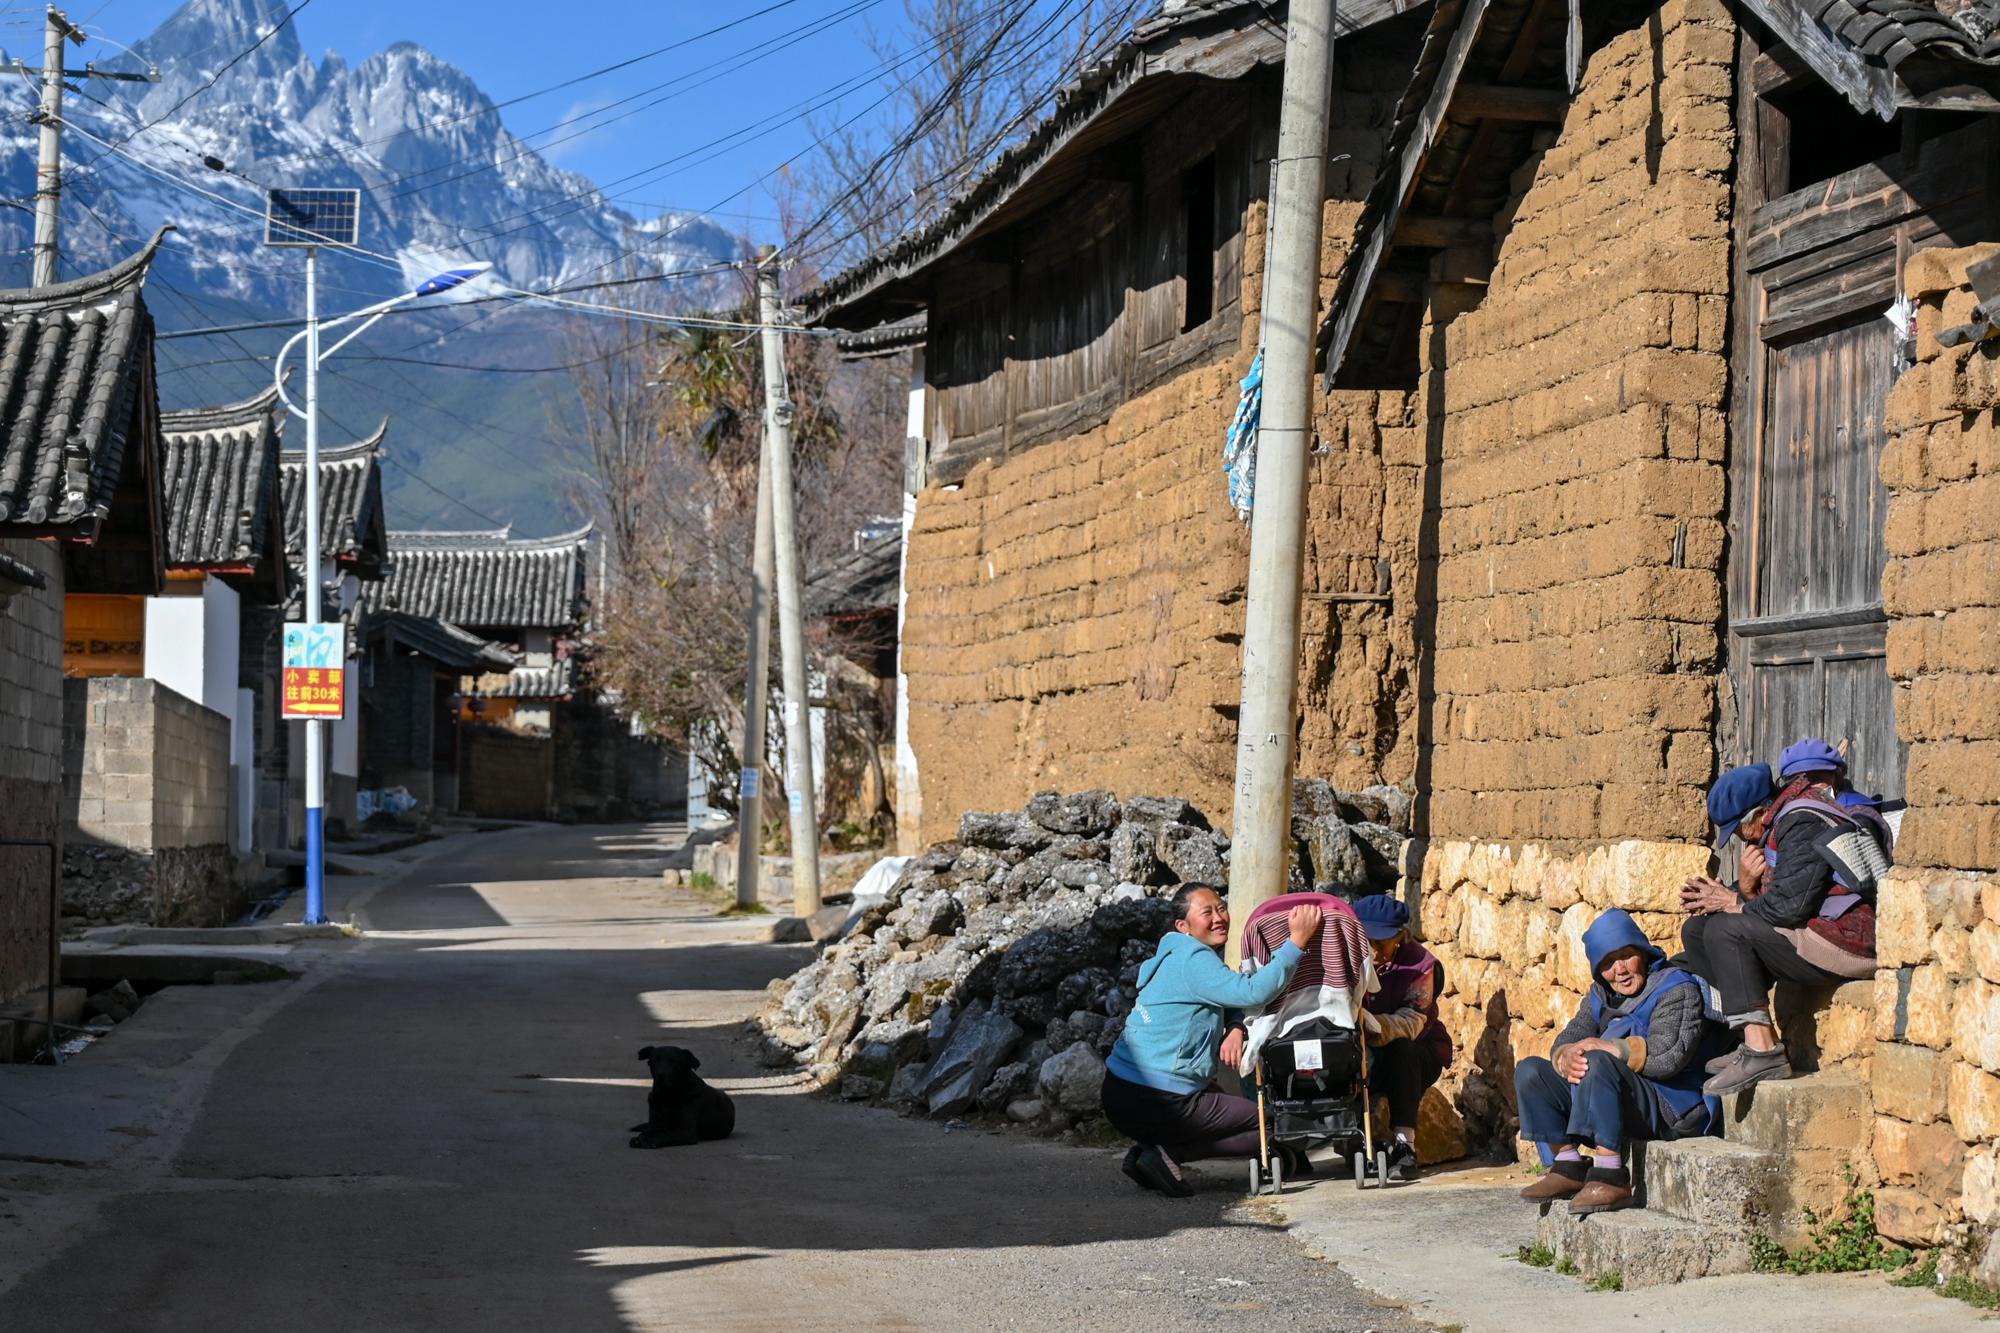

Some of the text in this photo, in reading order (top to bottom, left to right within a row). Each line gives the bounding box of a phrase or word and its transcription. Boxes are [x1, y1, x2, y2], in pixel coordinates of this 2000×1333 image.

[287, 669, 341, 684] 小卖部
[287, 686, 340, 701] 往前30米
